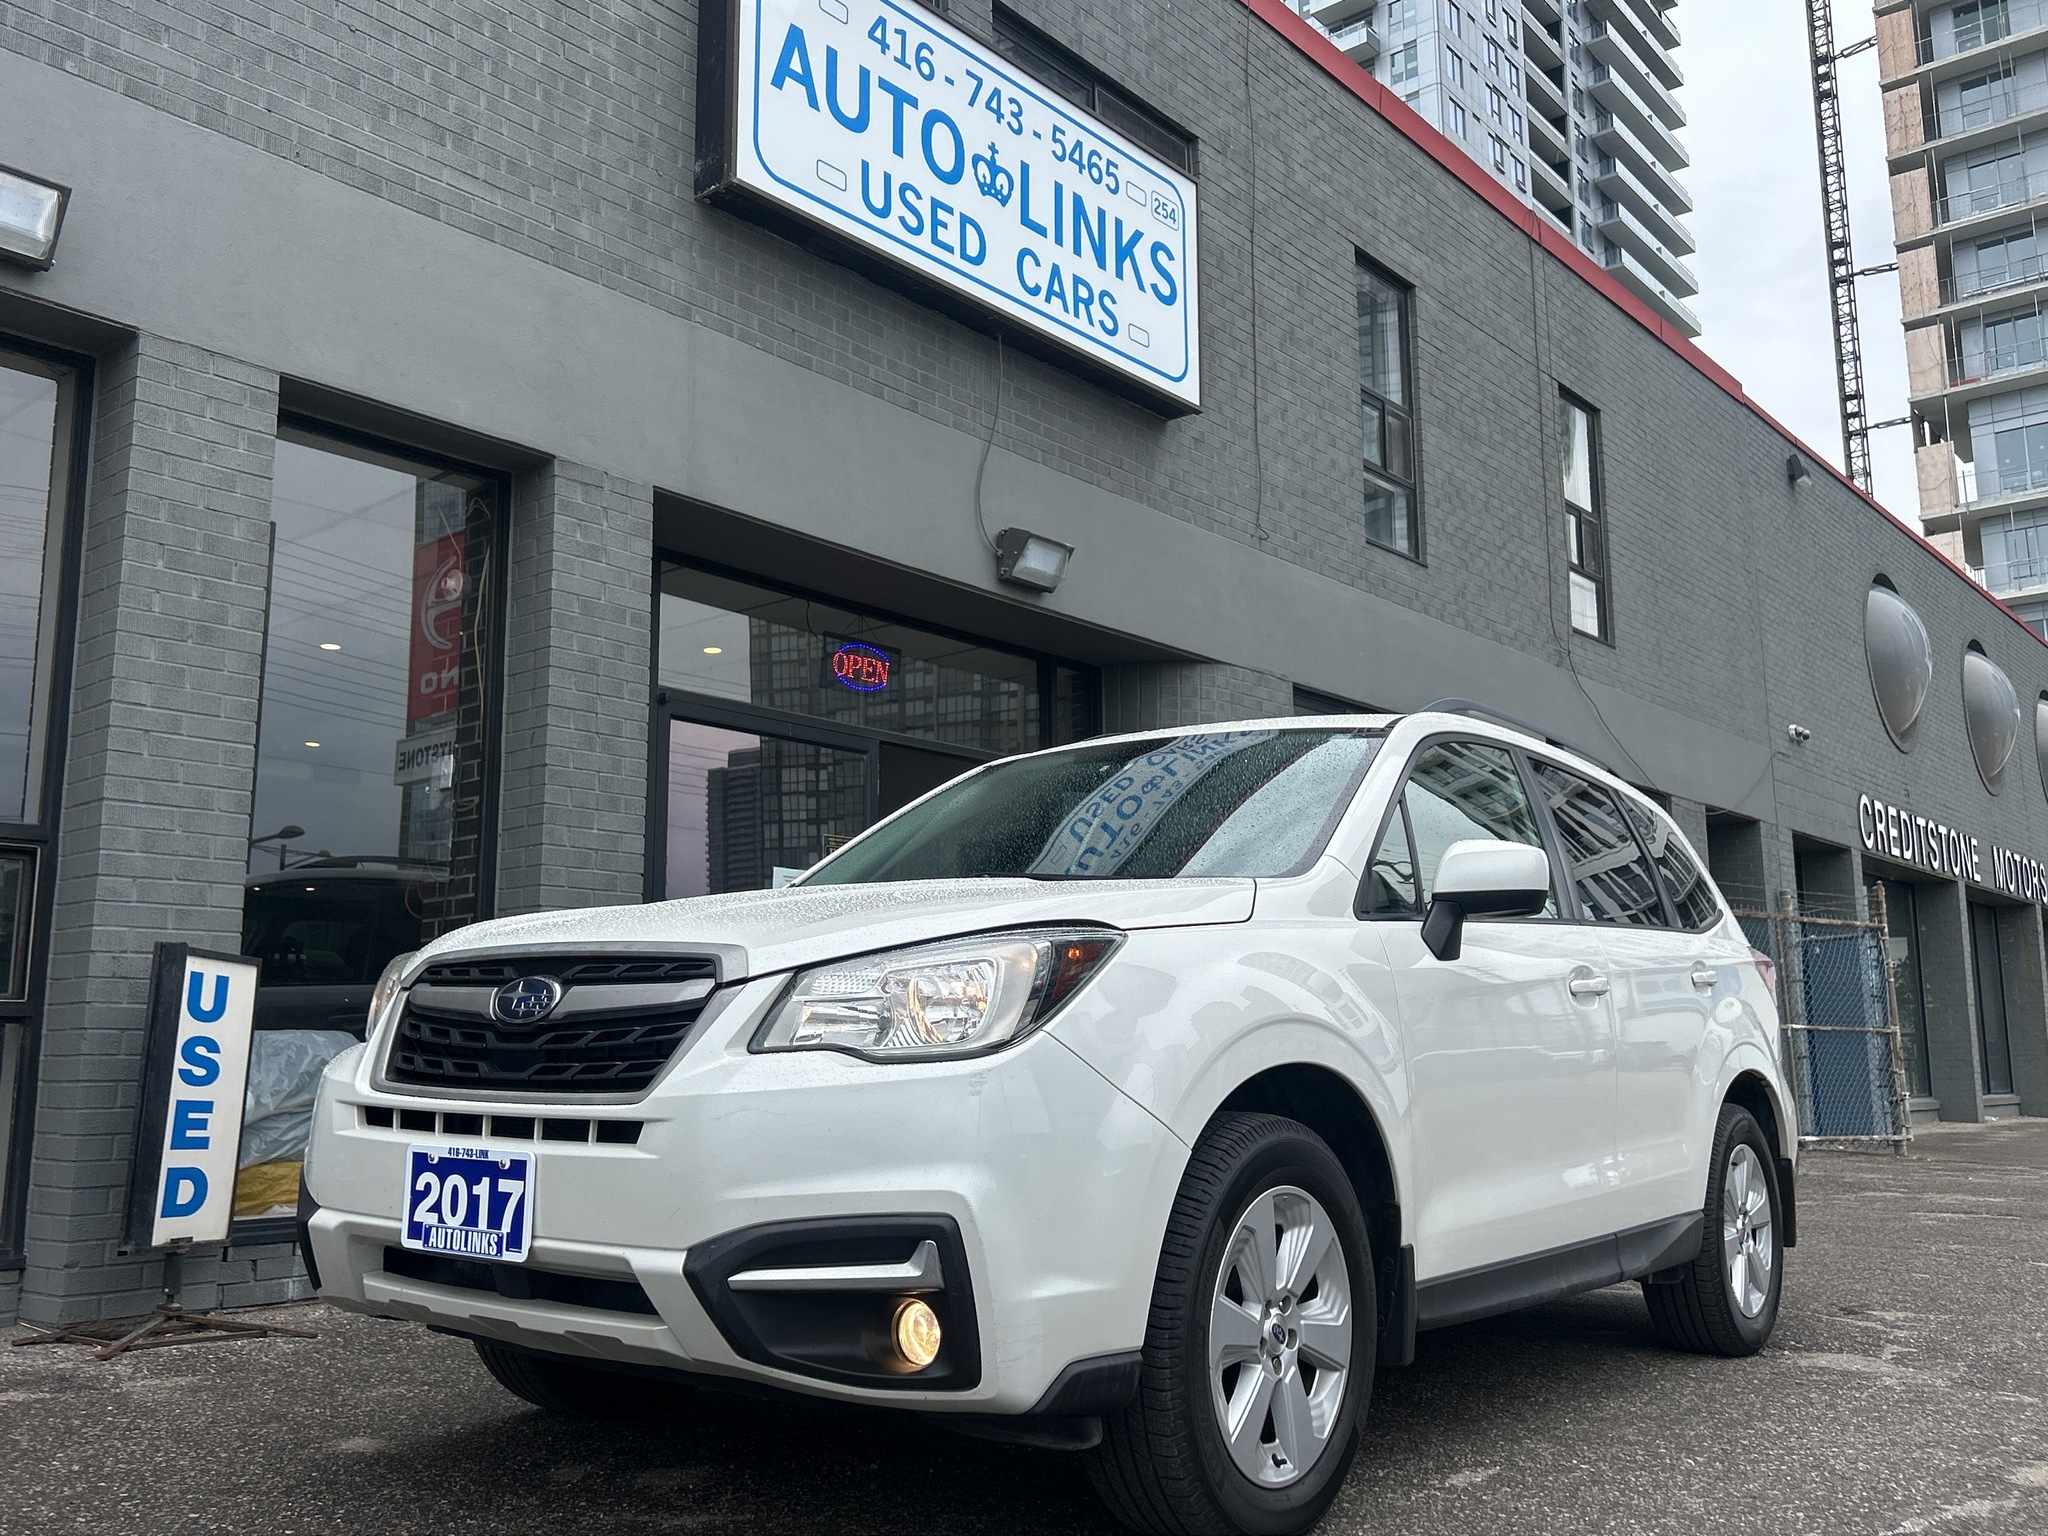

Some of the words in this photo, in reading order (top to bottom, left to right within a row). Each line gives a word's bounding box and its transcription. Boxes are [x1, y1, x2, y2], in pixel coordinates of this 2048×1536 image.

[770, 23, 965, 185] AUTO
[1019, 160, 1178, 306] LINKS
[860, 159, 987, 267] USED
[1016, 247, 1119, 337] CARS
[1153, 197, 1177, 225] 254
[832, 652, 890, 686] OPEN
[1859, 793, 1981, 883] CREDITSTONE
[1992, 845, 2048, 904] MOTORS
[160, 970, 230, 1219] USED
[413, 1171, 525, 1233] 2017
[428, 1225, 498, 1257] AUTOLINKS
